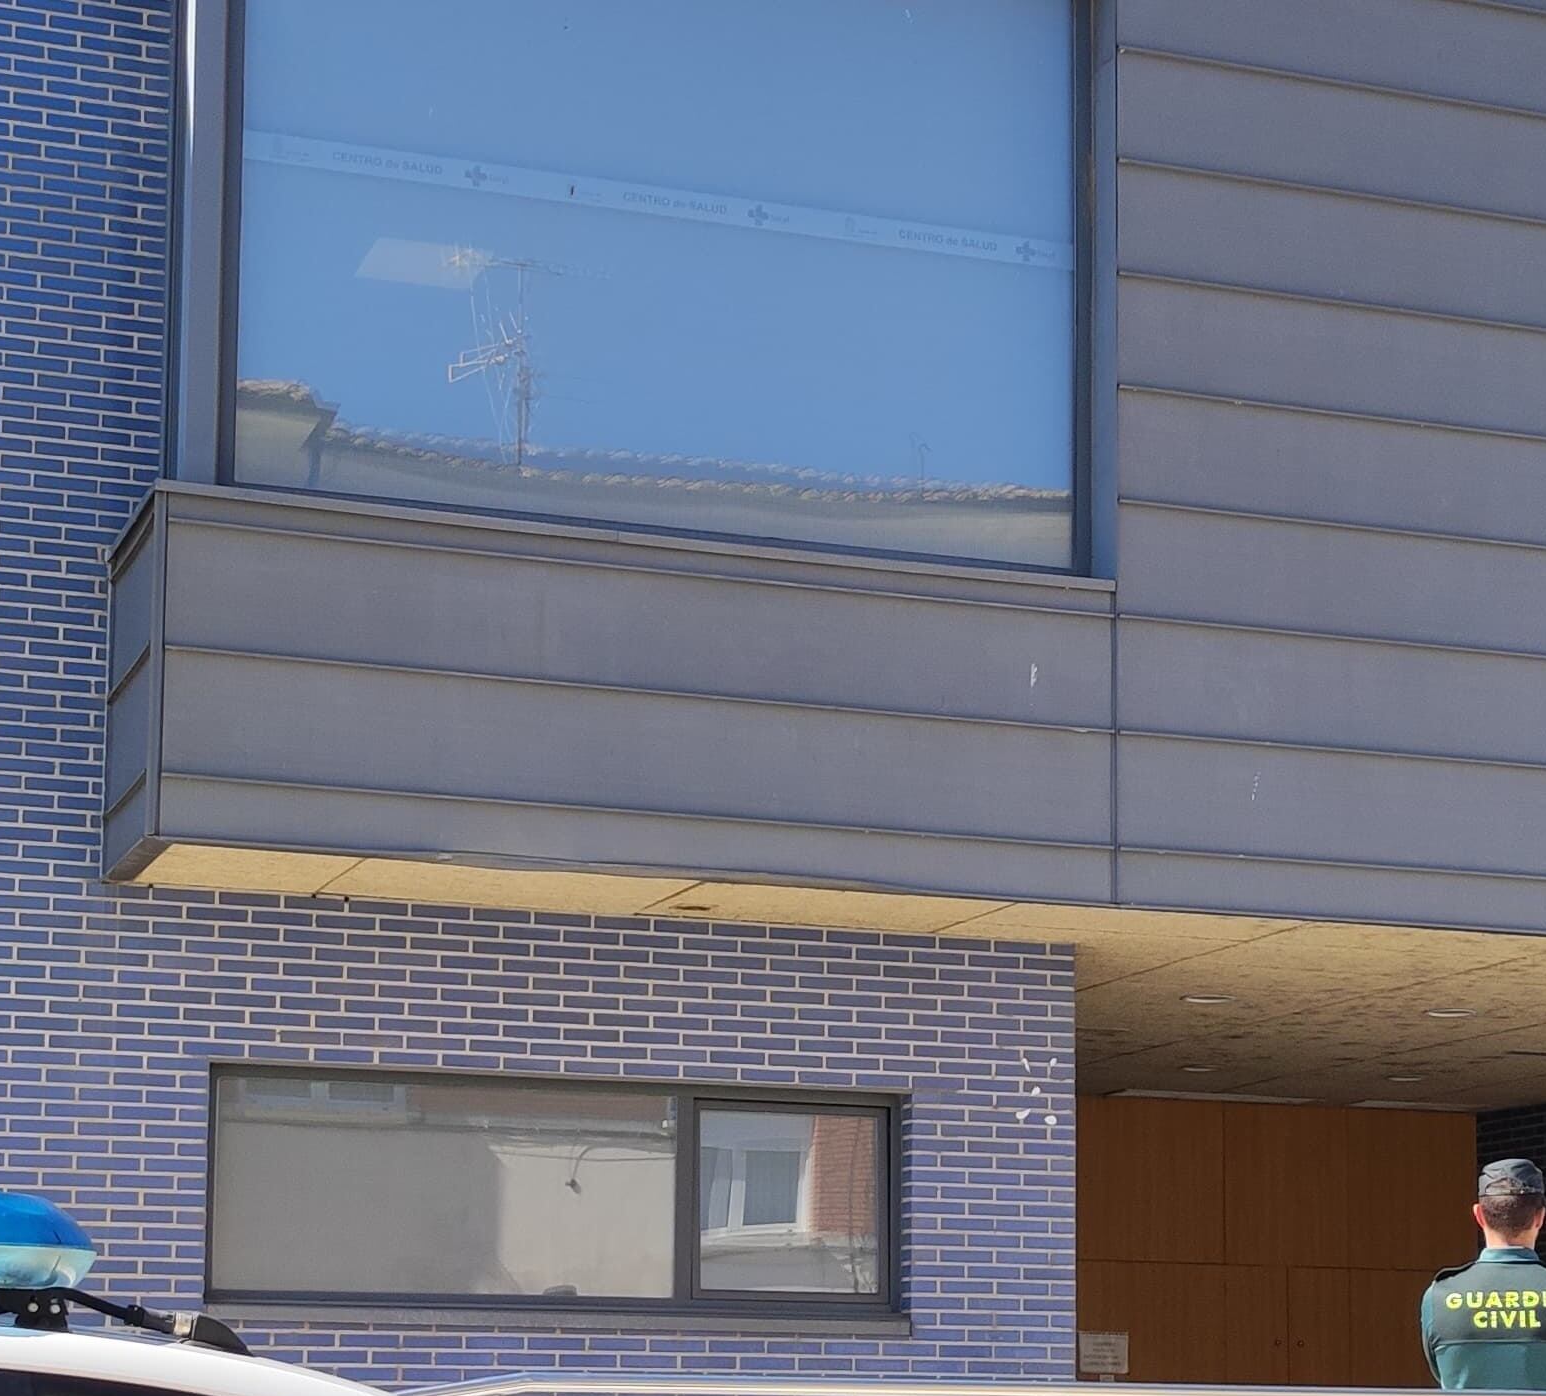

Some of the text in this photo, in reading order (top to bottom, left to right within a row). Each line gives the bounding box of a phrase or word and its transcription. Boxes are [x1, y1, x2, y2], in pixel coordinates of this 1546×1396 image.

[332, 151, 382, 167] CENTRO
[402, 160, 443, 175] SALUD
[623, 191, 670, 206] CENTRO
[690, 200, 727, 214] SALUD
[899, 229, 943, 244] CENTRO
[961, 237, 998, 251] SALUD
[1473, 1310, 1541, 1329] CIVIL
